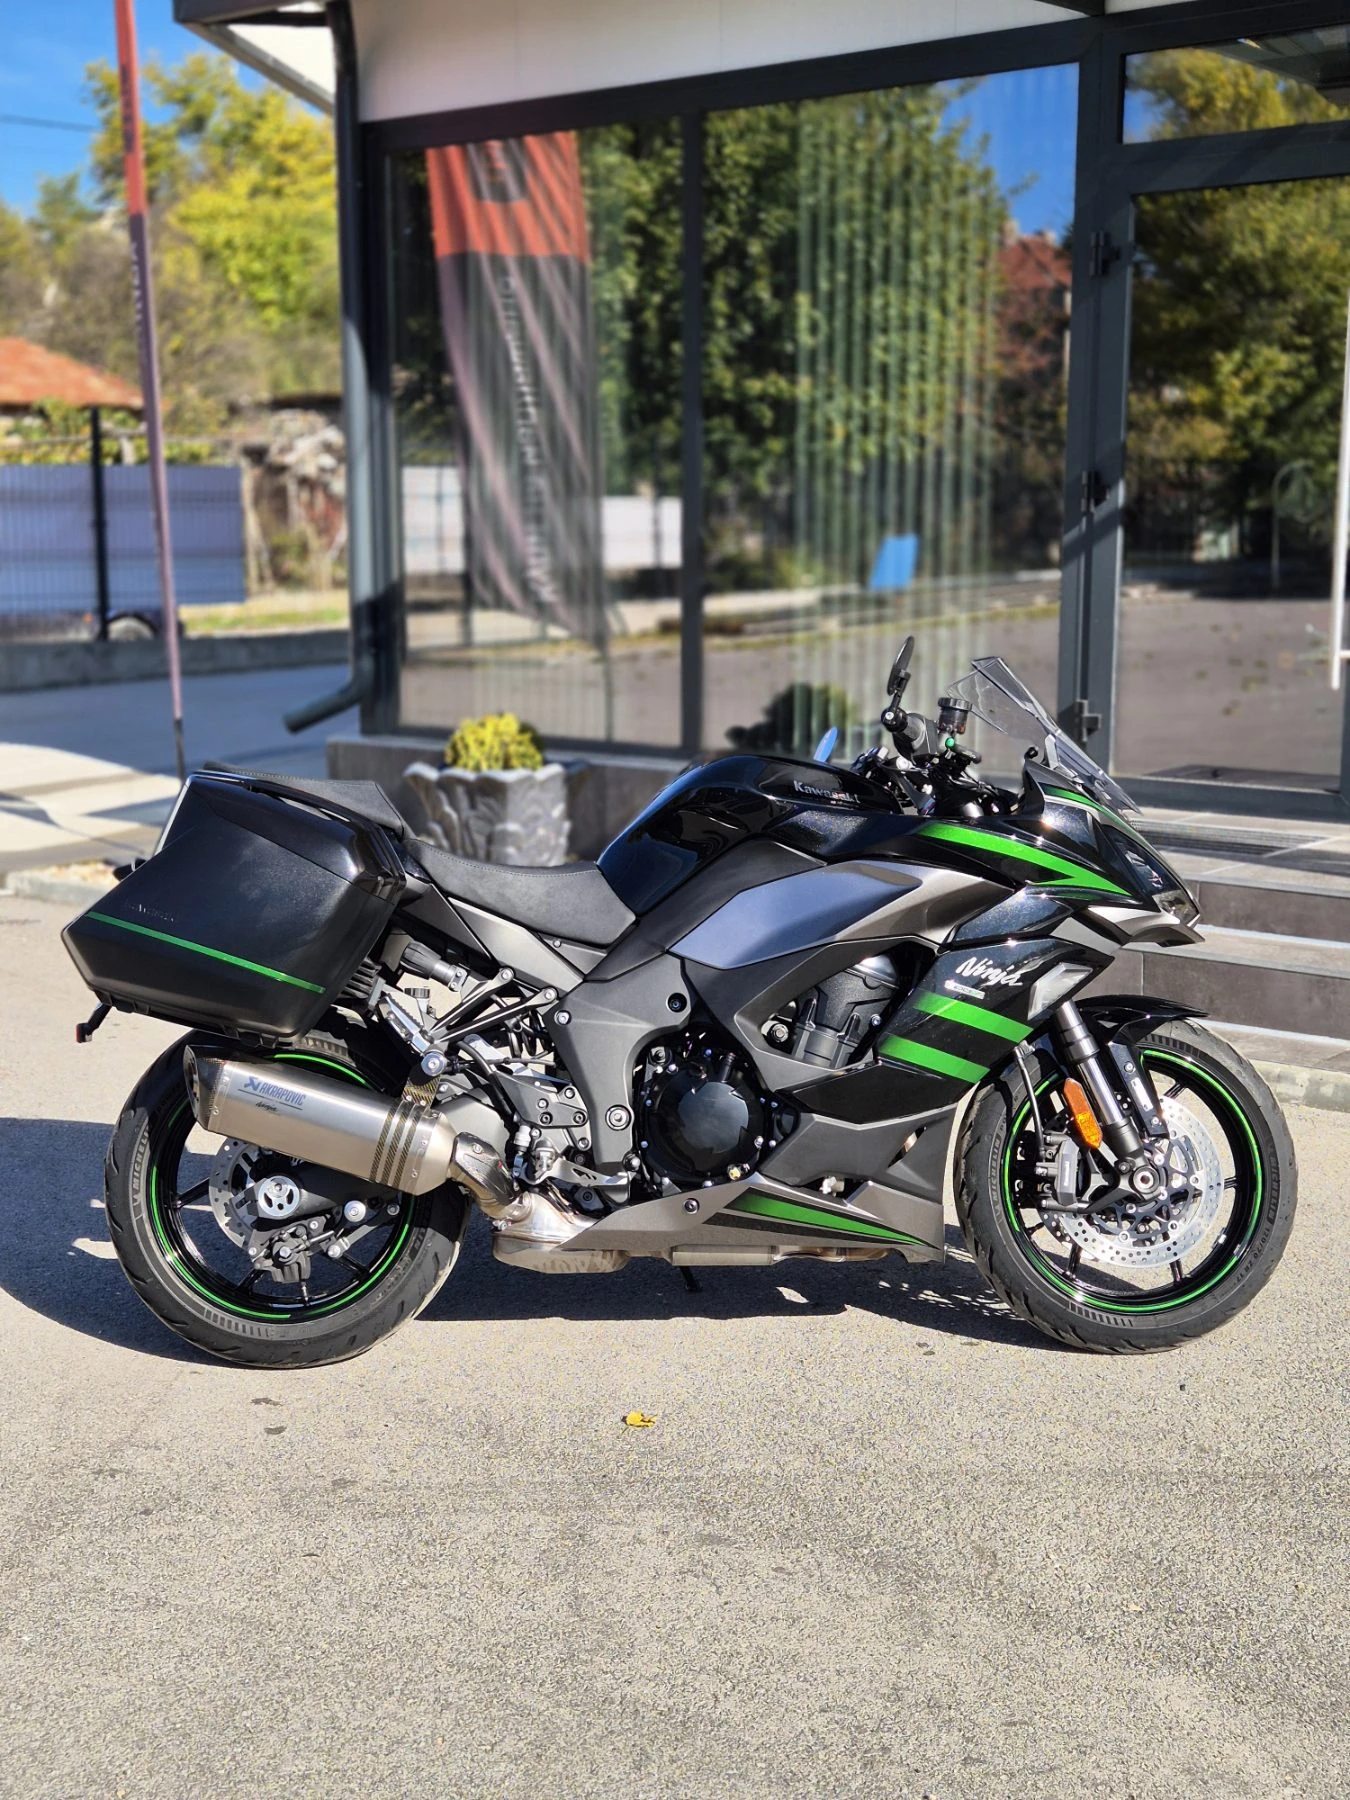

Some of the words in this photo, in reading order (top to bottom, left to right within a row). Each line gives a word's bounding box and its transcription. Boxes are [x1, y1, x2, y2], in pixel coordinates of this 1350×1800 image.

[955, 956, 1023, 990] Ninja
[991, 1138, 1001, 1201] MICHELIN
[1269, 1156, 1280, 1221] MICHELIN
